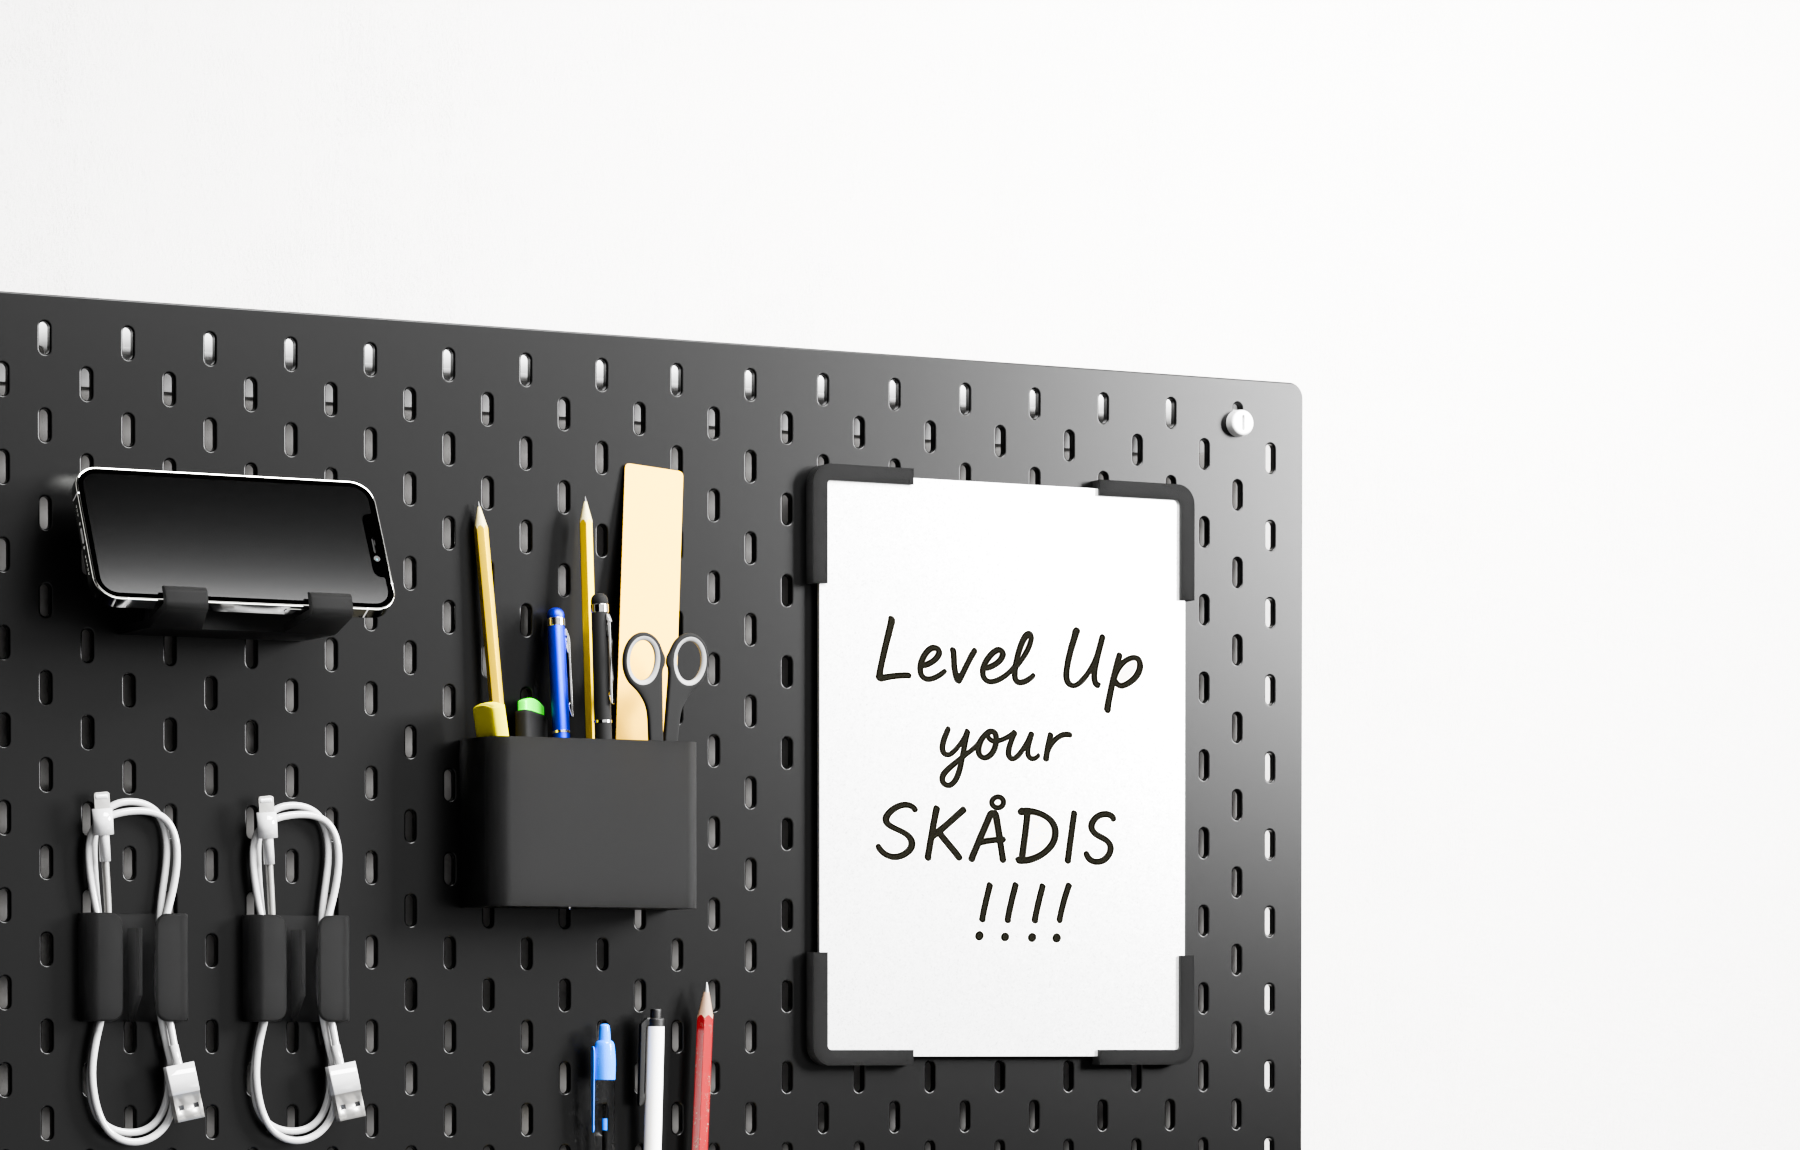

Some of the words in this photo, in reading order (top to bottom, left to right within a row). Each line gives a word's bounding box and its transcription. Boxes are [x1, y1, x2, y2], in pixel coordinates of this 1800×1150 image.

[875, 615, 1036, 686] Level
[1062, 627, 1144, 714] Up
[939, 726, 1073, 789] your
[875, 794, 1117, 866] SKÅDIS
